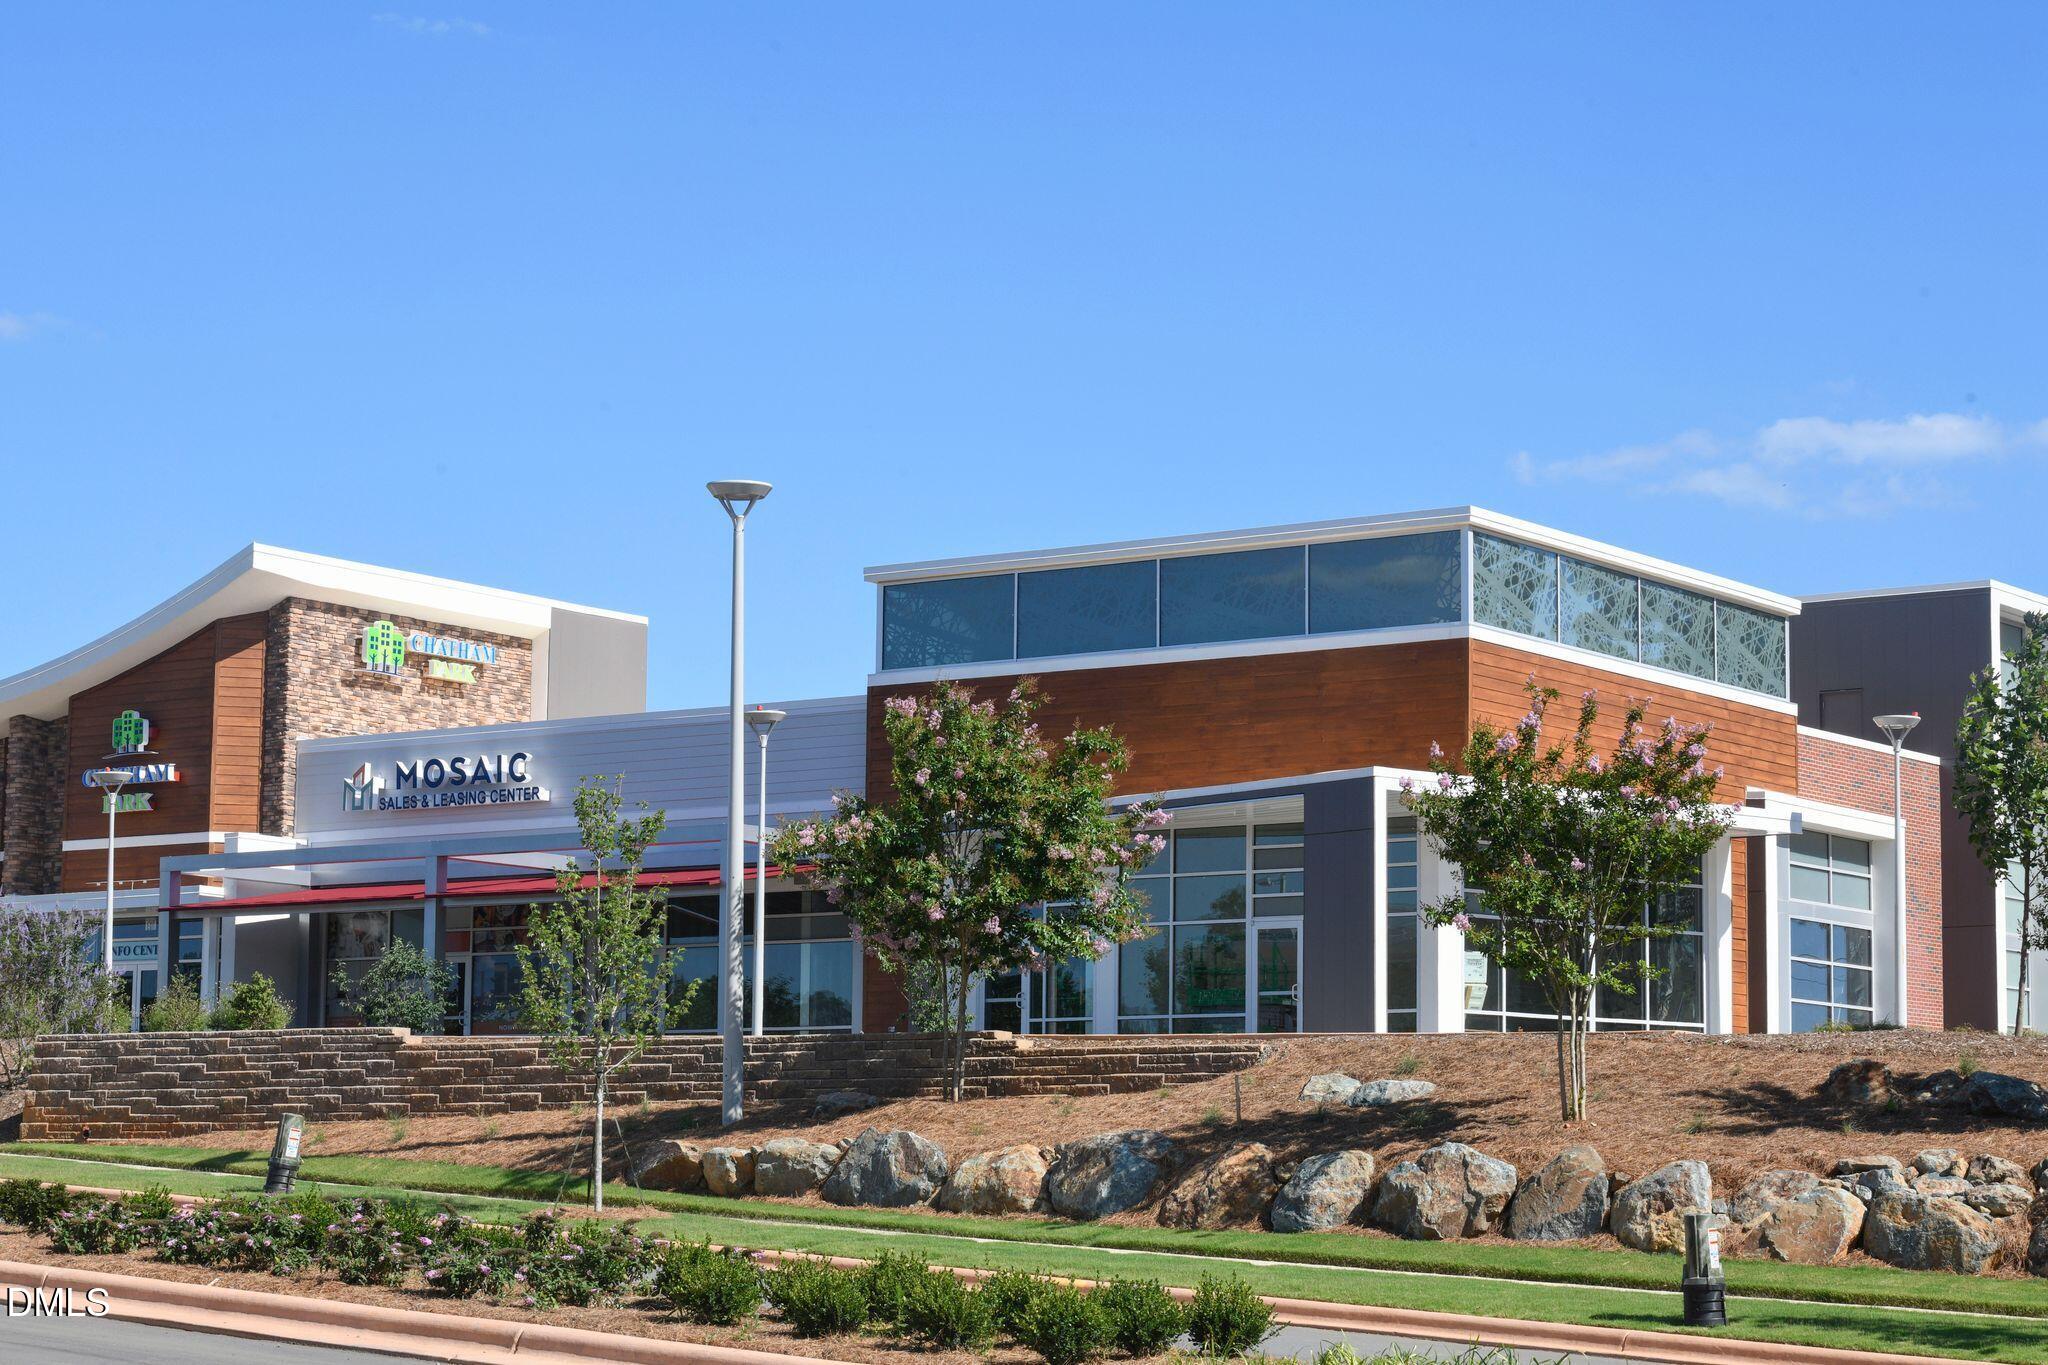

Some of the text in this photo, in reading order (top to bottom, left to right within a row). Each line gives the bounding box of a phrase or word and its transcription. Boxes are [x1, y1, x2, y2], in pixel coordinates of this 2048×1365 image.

[411, 634, 497, 665] CHATHAM
[431, 660, 477, 684] PARK
[82, 764, 174, 788] CHAM
[396, 752, 529, 789] MOSAIC
[379, 786, 540, 811] SALES & LEASING CENTER
[112, 945, 131, 957] NFO
